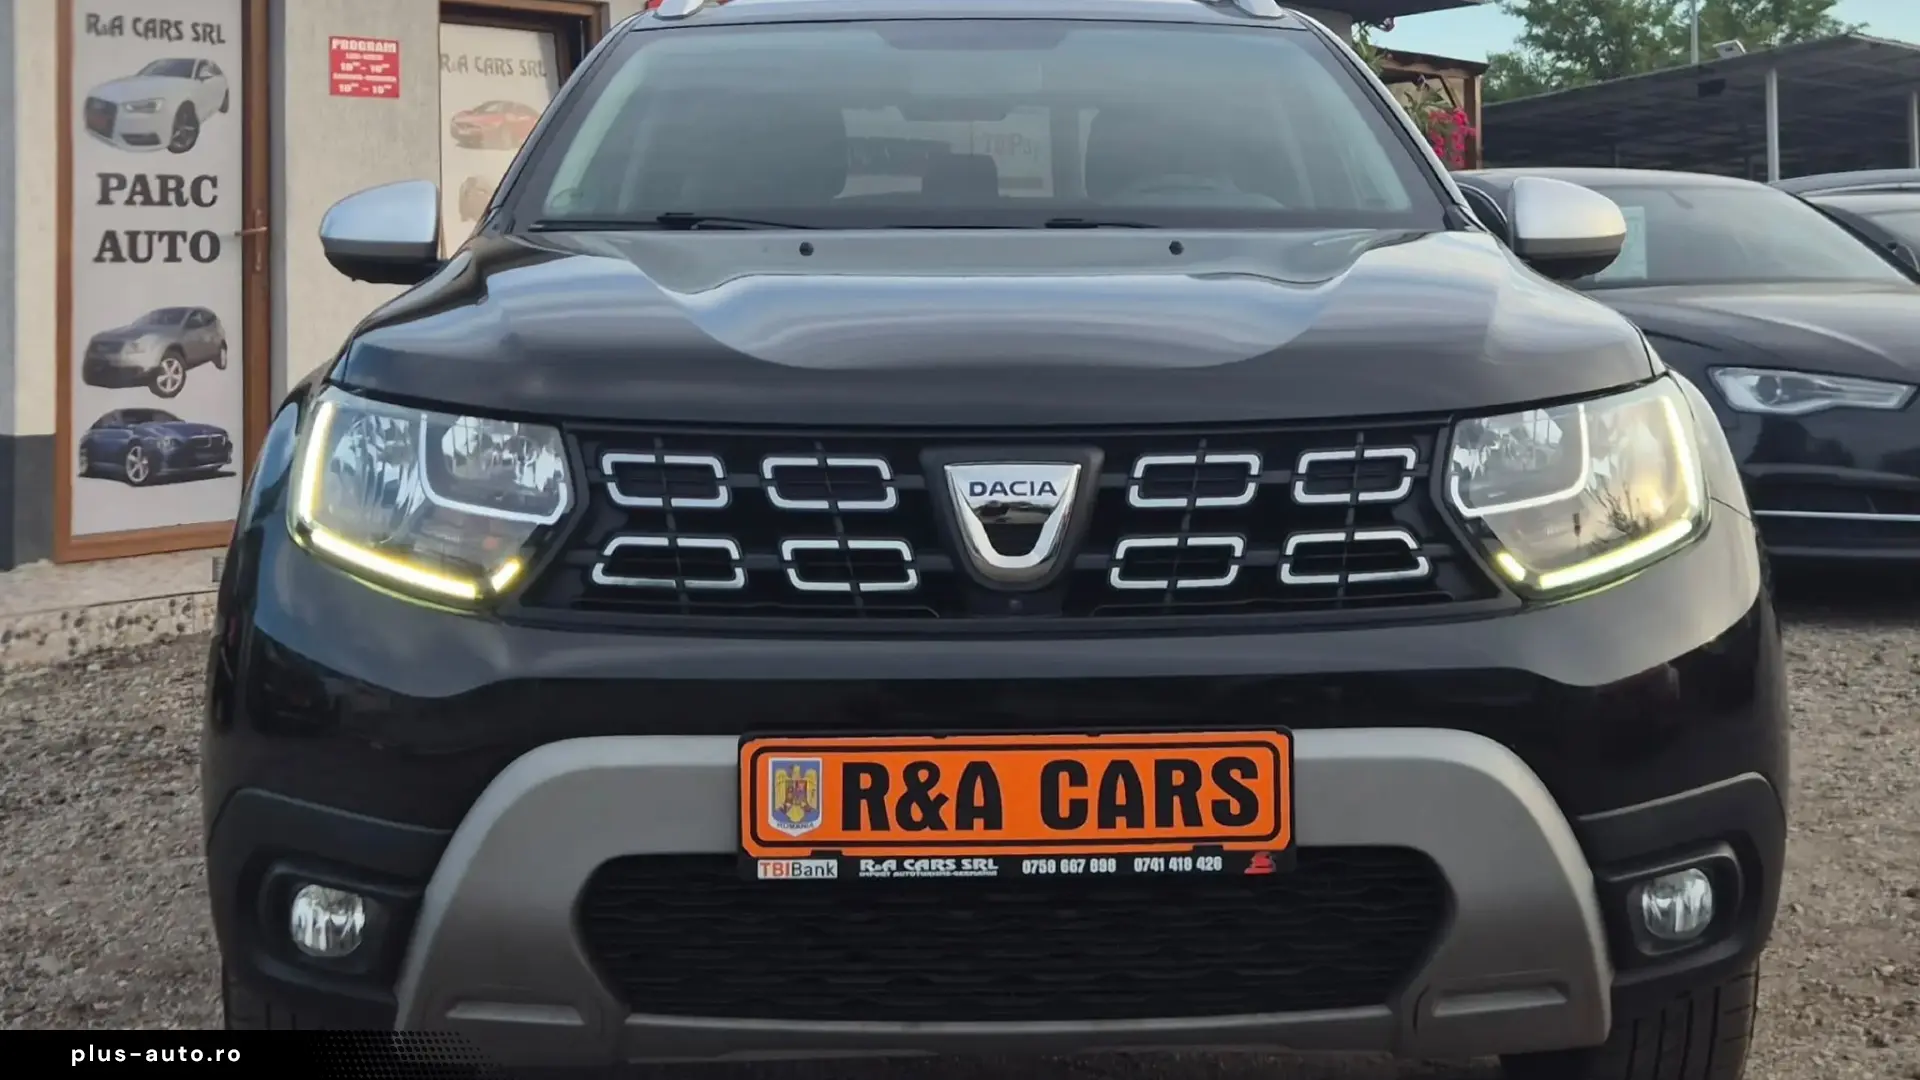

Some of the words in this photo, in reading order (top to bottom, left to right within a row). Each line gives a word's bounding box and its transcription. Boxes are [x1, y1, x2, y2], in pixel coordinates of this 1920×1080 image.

[132, 16, 184, 42] CARS
[191, 21, 226, 45] SRL
[332, 38, 397, 53] PROGRAM
[474, 55, 515, 77] CARS
[518, 57, 548, 78] SRL
[96, 171, 218, 208] PARC
[92, 229, 221, 264] AUTO
[969, 481, 1058, 497] DACIA
[841, 760, 1003, 832] R&A
[1040, 756, 1260, 831] CARS
[903, 859, 956, 871] CARS
[961, 858, 999, 871] SRL
[1133, 858, 1165, 873] 0741
